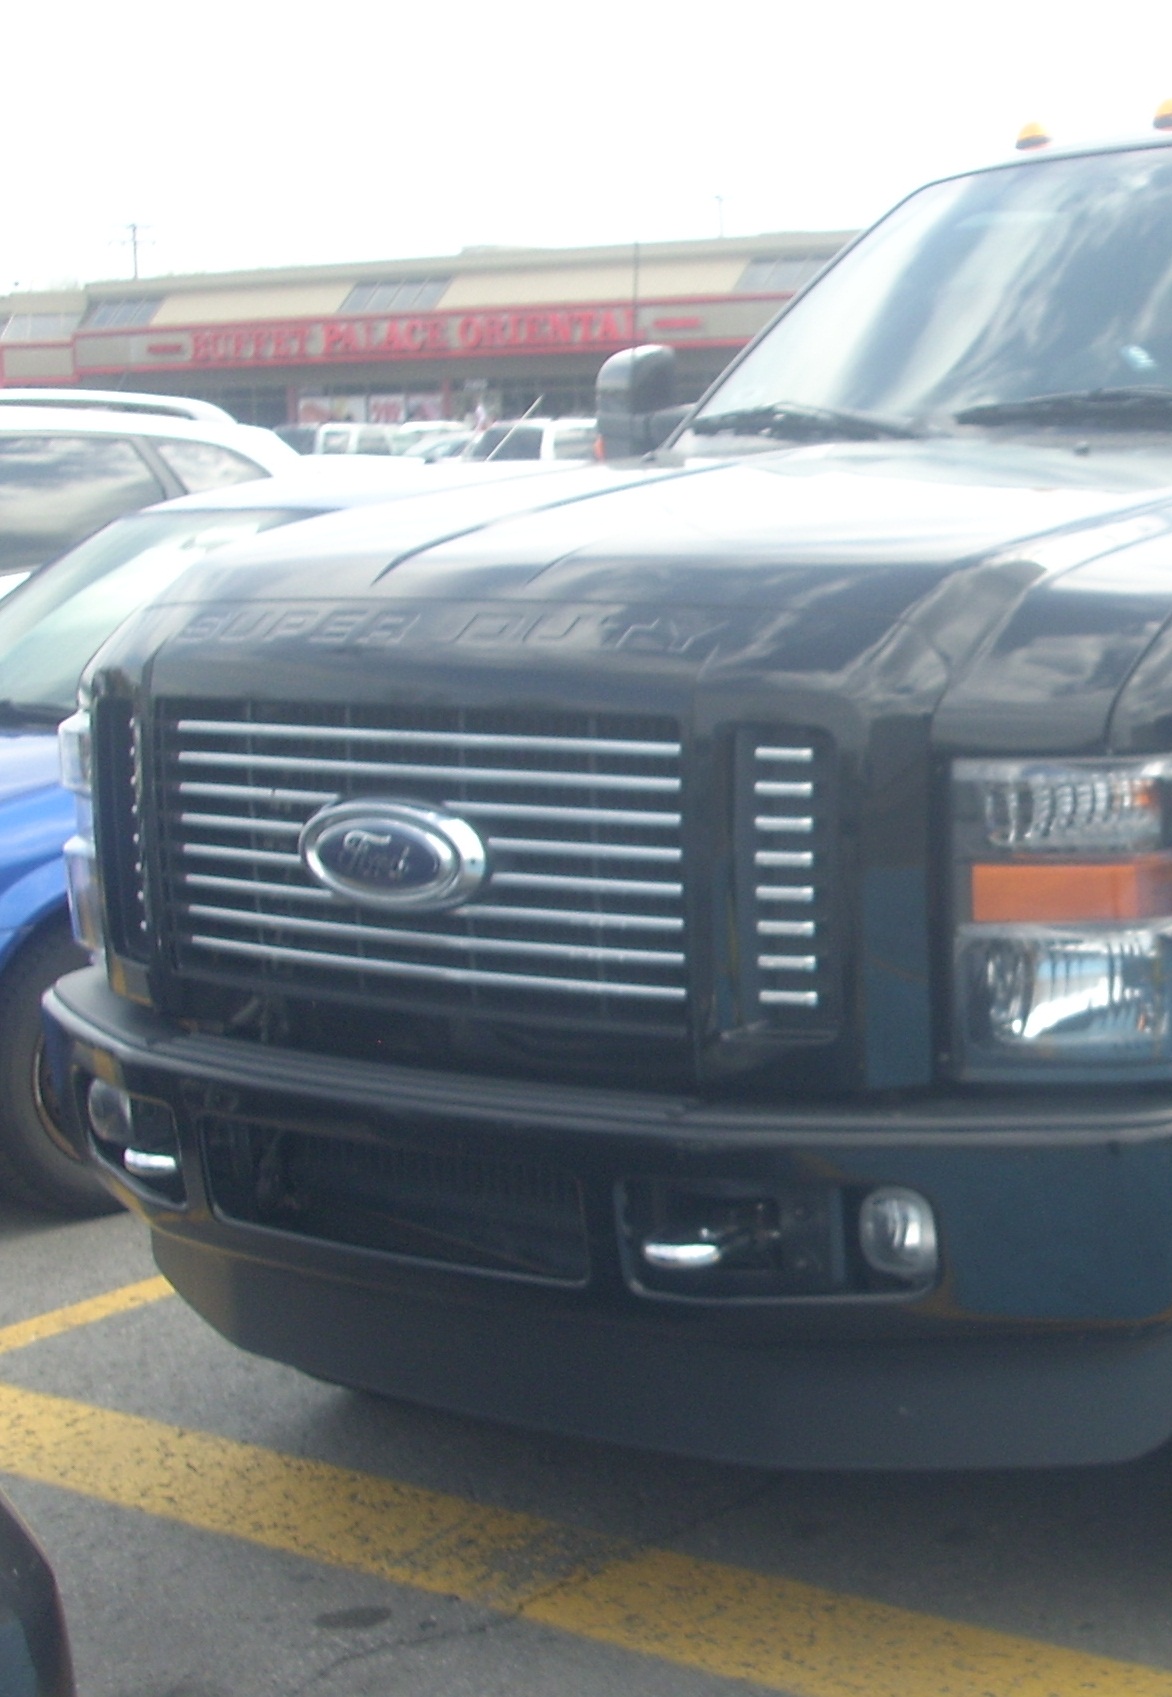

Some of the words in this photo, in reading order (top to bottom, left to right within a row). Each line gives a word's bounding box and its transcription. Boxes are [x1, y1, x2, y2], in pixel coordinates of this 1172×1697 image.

[190, 329, 311, 362] BUFFET
[322, 318, 447, 354] PALACE
[458, 309, 643, 350] ORIENTAL
[175, 607, 419, 645] SUPER
[449, 610, 728, 653] DUTY
